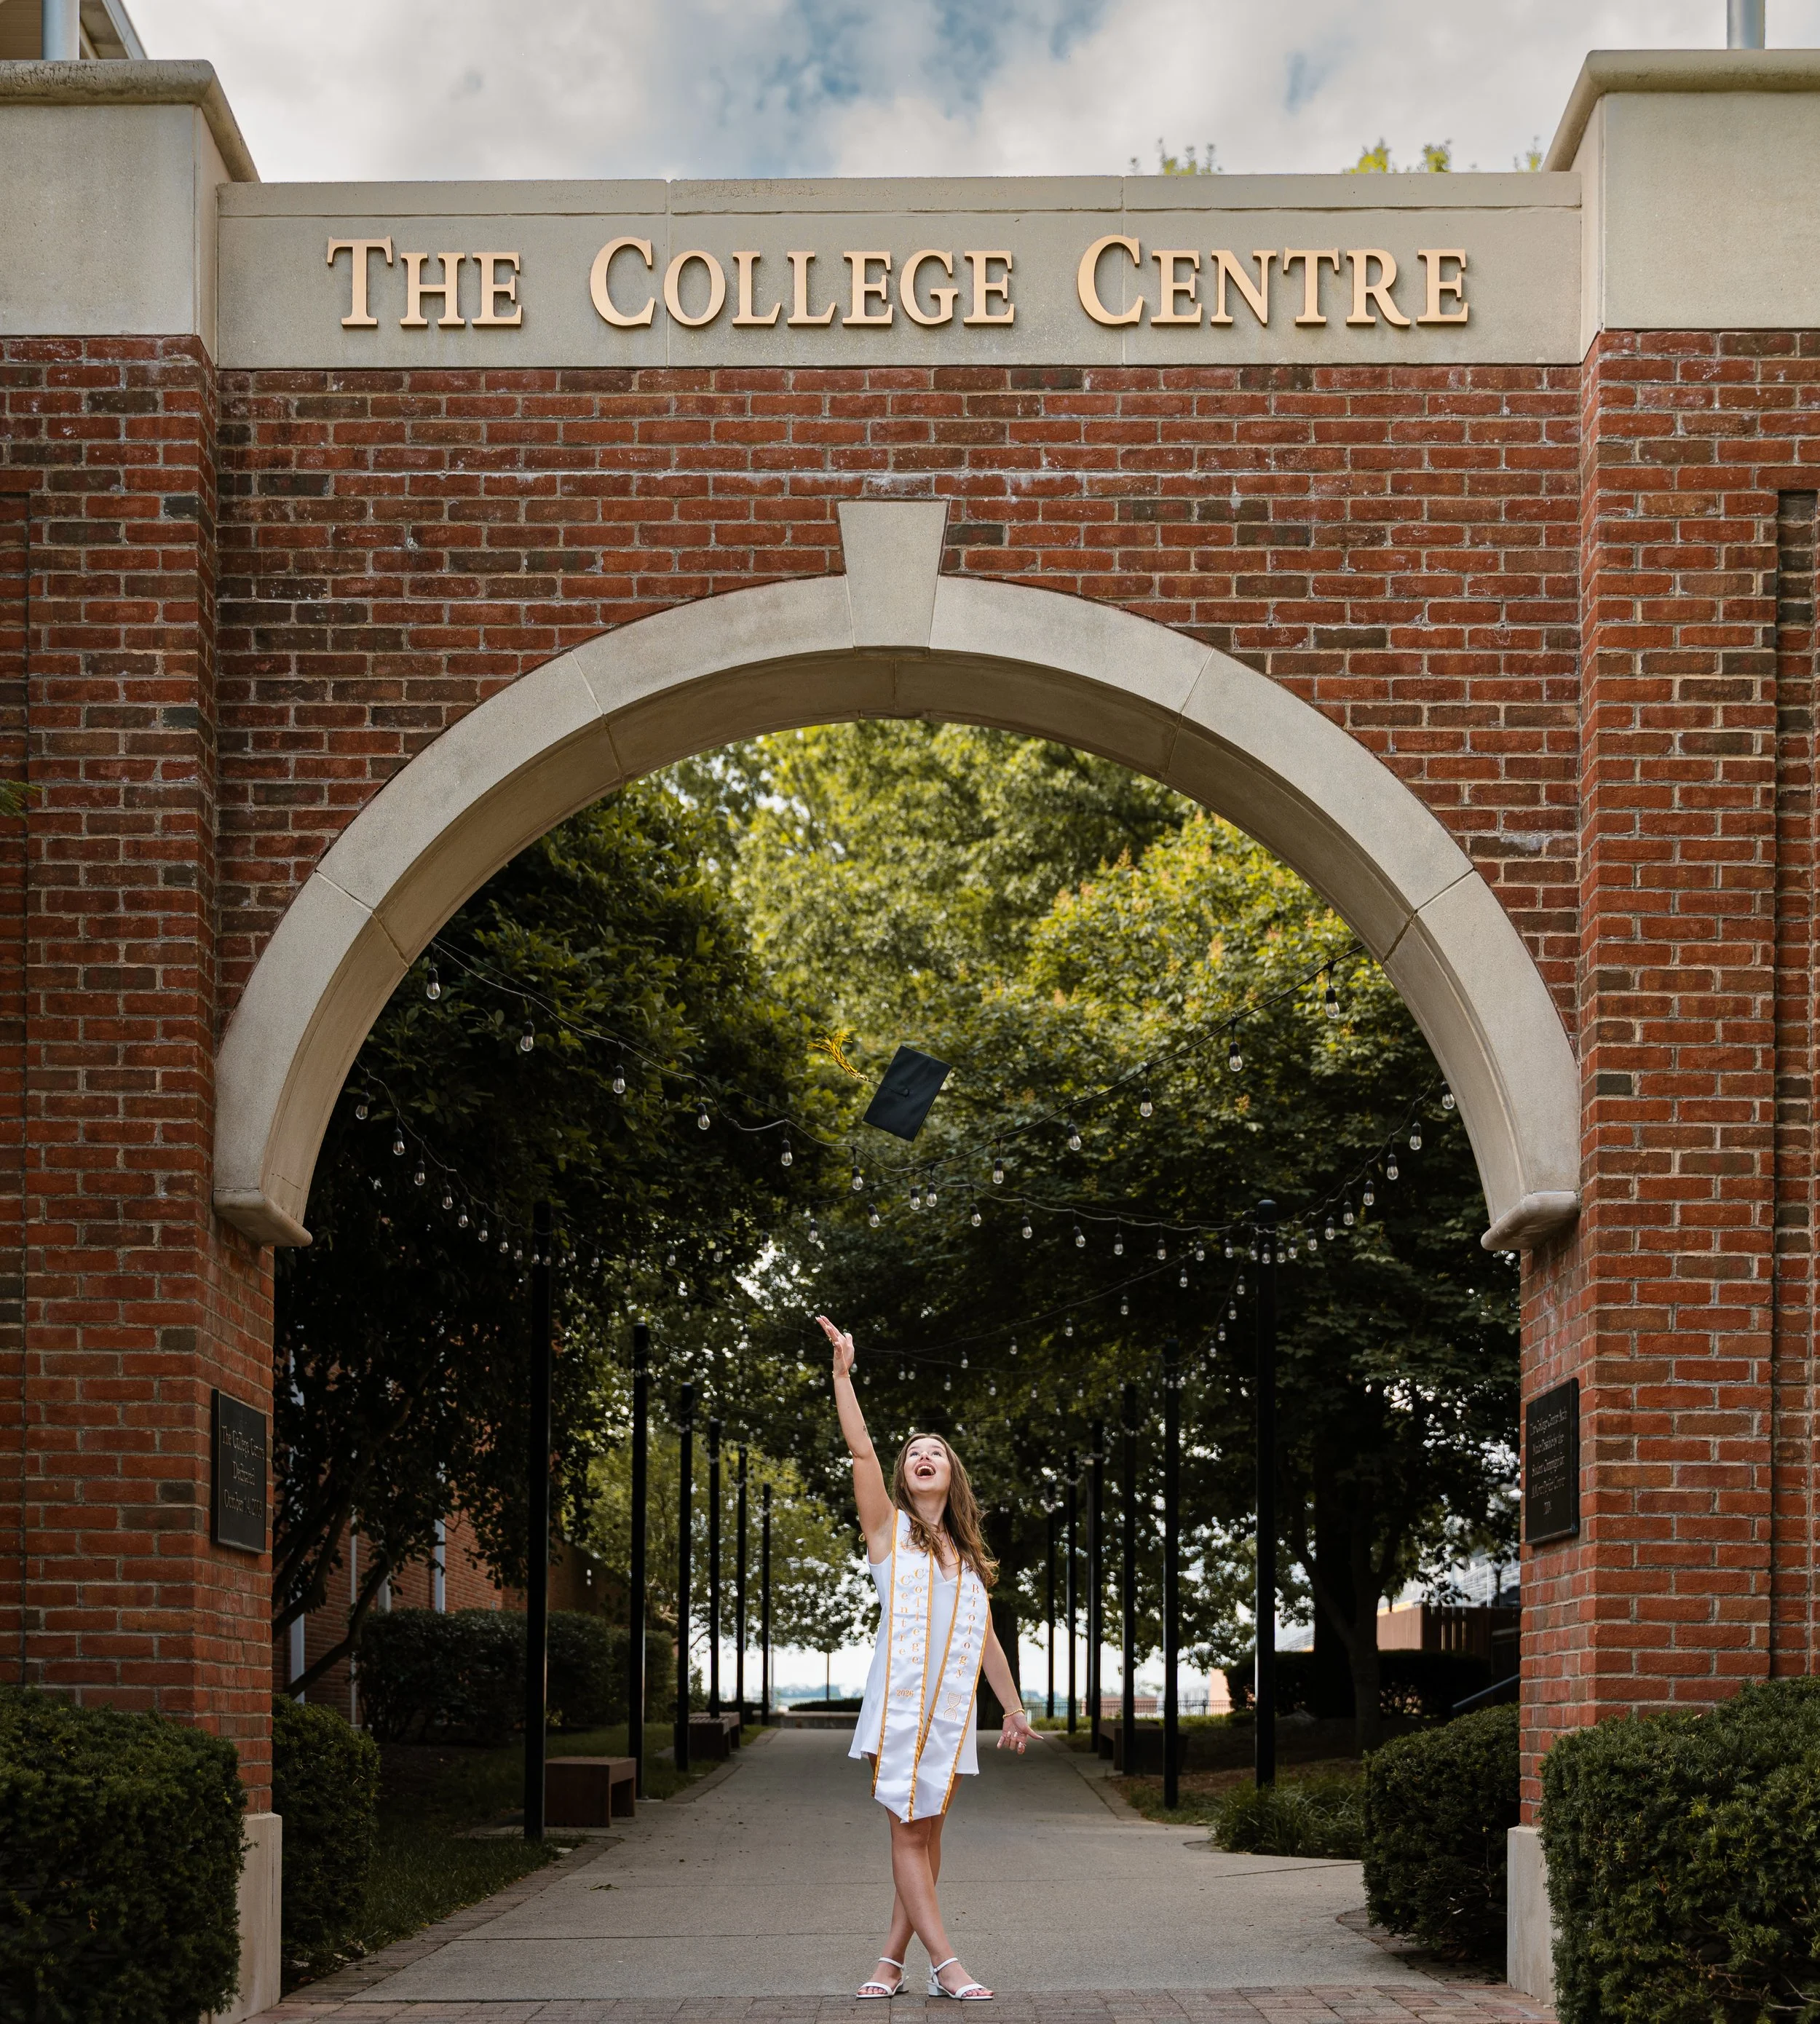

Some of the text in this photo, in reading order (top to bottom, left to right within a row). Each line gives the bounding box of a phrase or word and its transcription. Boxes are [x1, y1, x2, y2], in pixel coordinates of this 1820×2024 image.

[328, 234, 1470, 328] THE COLLEGE CENTRE
[221, 1425, 232, 1447] The
[232, 1430, 250, 1458] College
[900, 1574, 911, 1655] Centre
[911, 1568, 925, 1664] College
[955, 1583, 979, 1678] Biology
[896, 1689, 914, 1697] 2026
